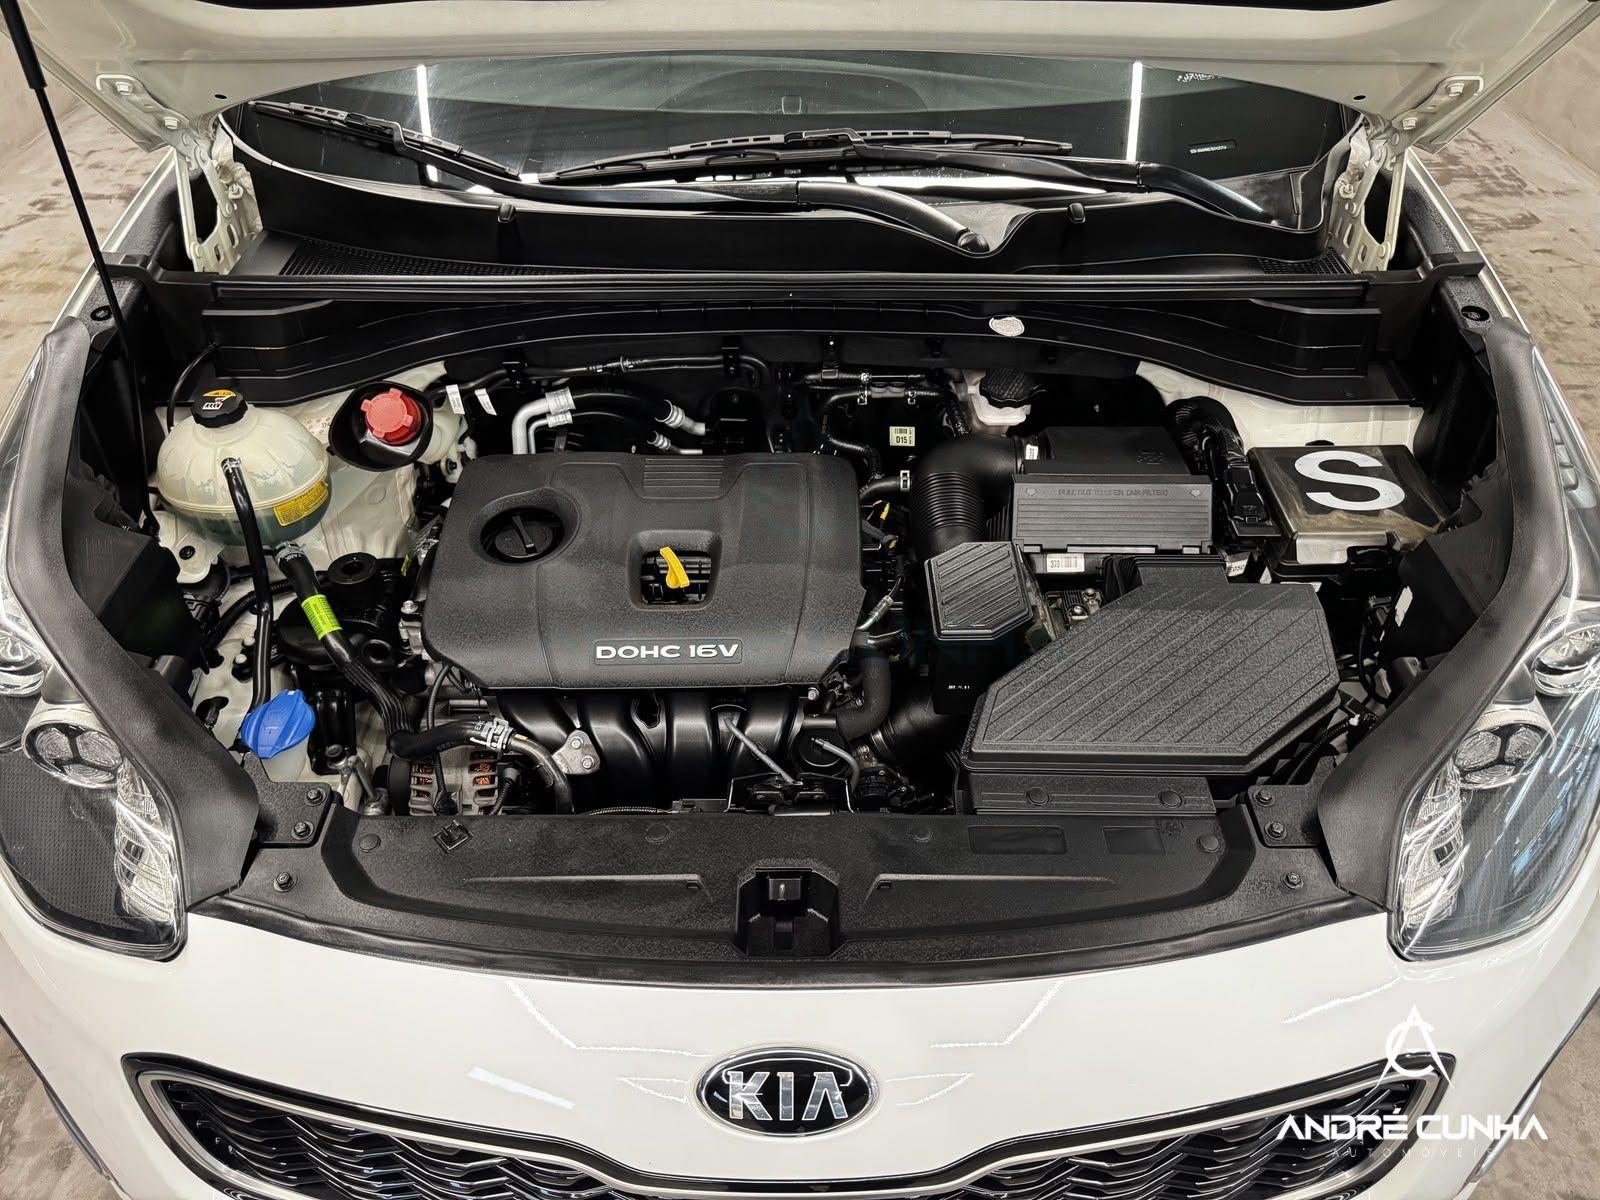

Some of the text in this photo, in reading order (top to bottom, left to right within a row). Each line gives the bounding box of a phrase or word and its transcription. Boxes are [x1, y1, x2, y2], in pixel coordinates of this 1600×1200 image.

[1294, 450, 1405, 511] S
[596, 643, 739, 659] DOHC 16V
[726, 1071, 849, 1121] KIA
